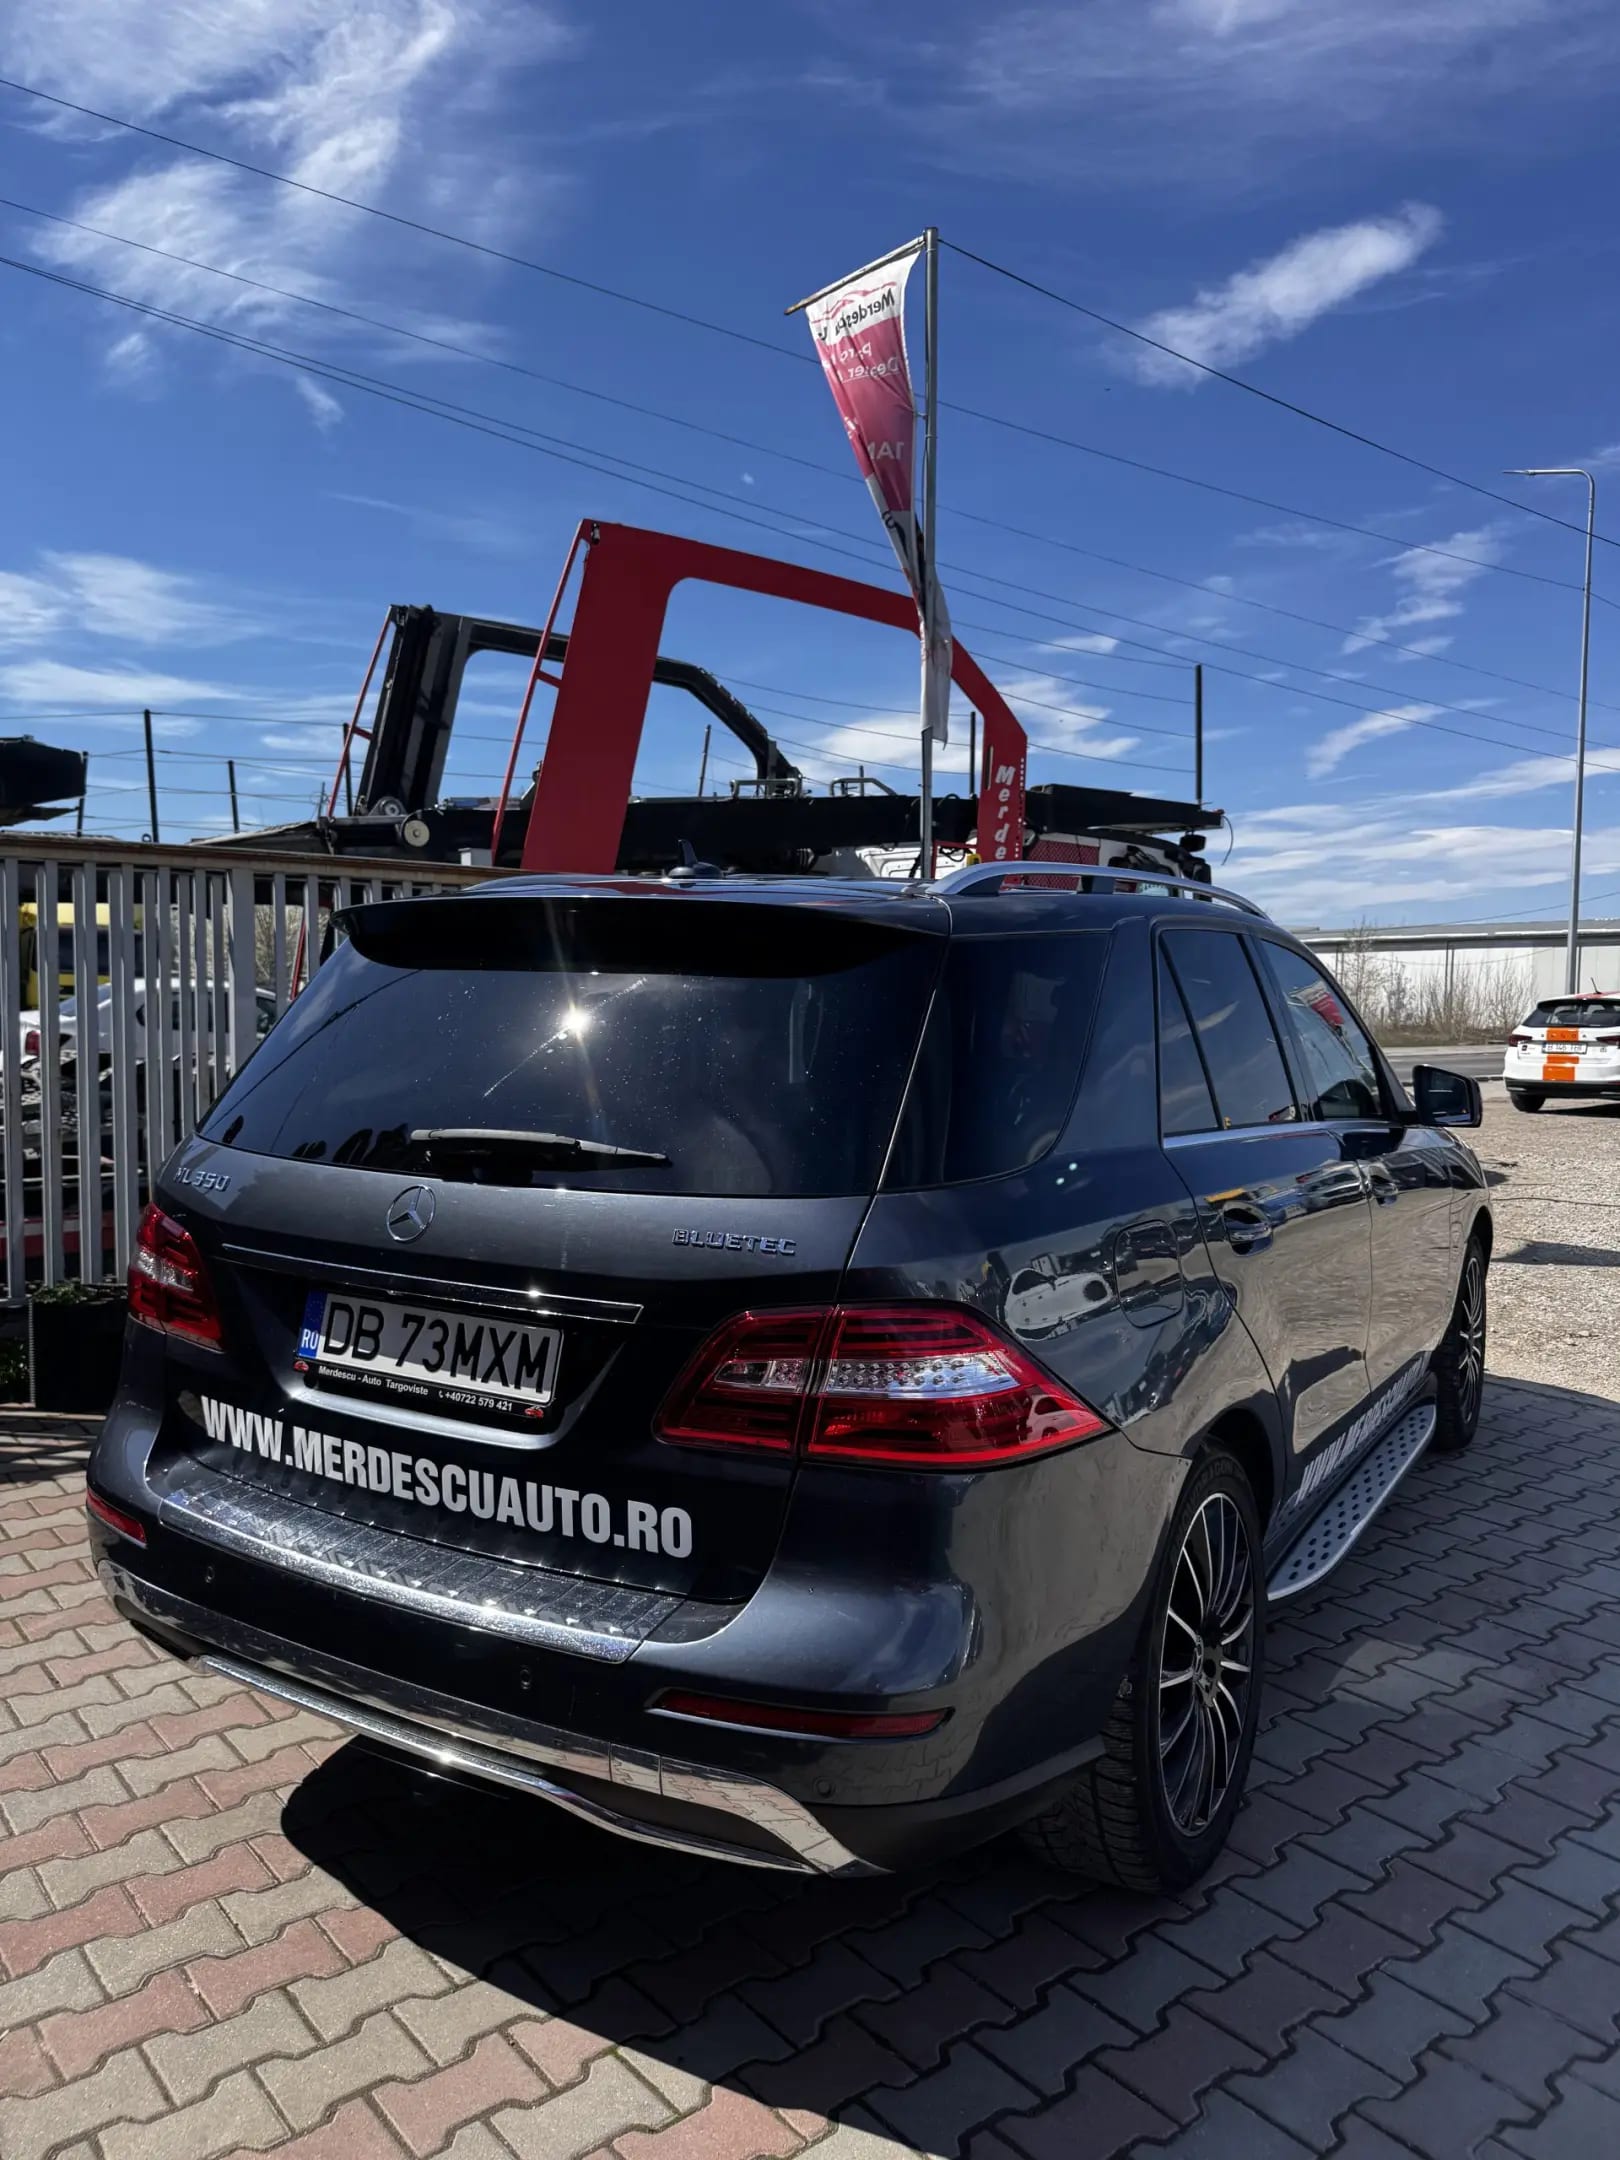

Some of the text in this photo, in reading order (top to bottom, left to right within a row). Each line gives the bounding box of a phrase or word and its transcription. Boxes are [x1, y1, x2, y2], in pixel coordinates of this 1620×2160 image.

[672, 1228, 797, 1256] BLUETEC
[323, 1302, 551, 1394] DB 73MXM
[318, 1365, 356, 1381] Merdescu
[362, 1374, 382, 1386] Auto
[386, 1379, 429, 1396] Targoviste
[478, 1397, 495, 1409] 579
[496, 1401, 513, 1412] 421
[201, 1394, 693, 1558] WWW.MERDESCUAUTO.RO
